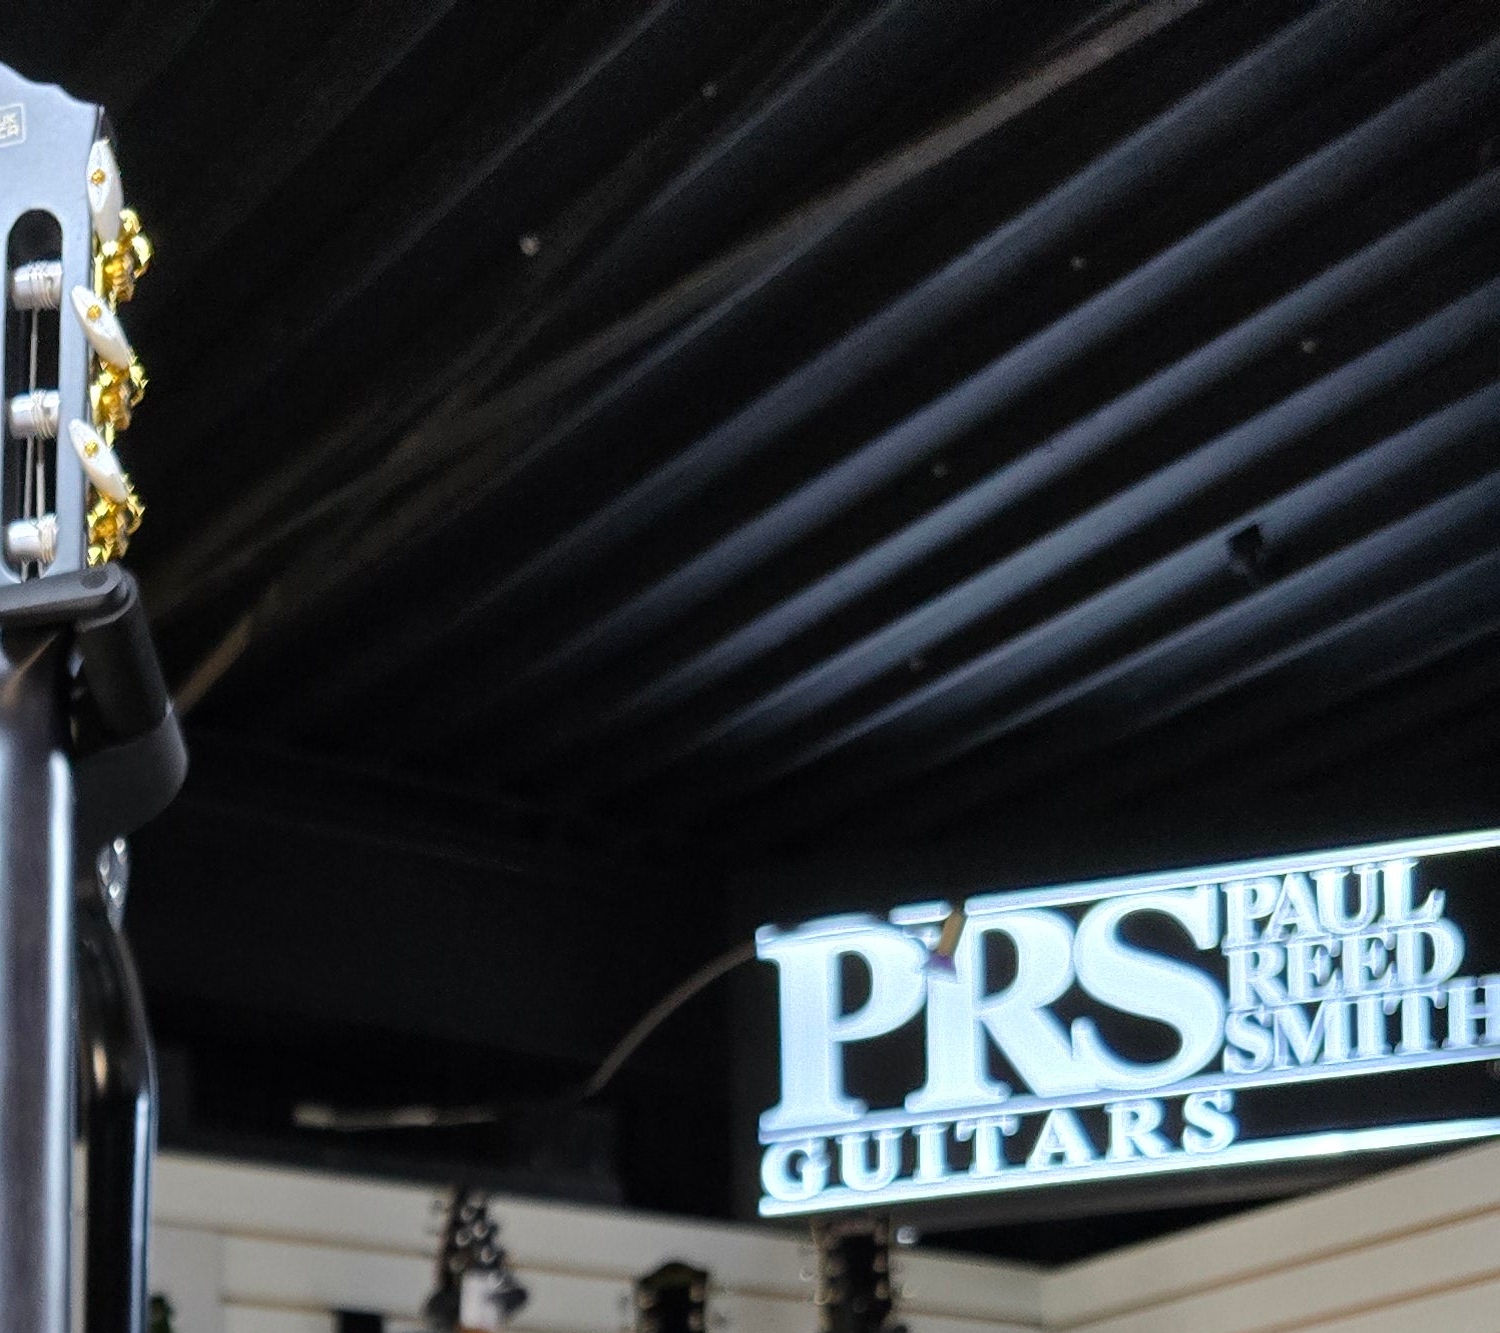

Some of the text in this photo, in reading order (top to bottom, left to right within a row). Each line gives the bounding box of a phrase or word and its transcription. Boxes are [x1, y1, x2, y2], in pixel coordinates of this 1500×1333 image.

[1220, 858, 1447, 953] PAUL
[756, 882, 1227, 1131] PRS
[1224, 917, 1466, 1012] REED
[1222, 974, 1500, 1075] SMITH
[759, 1090, 1240, 1202] GUITARS
